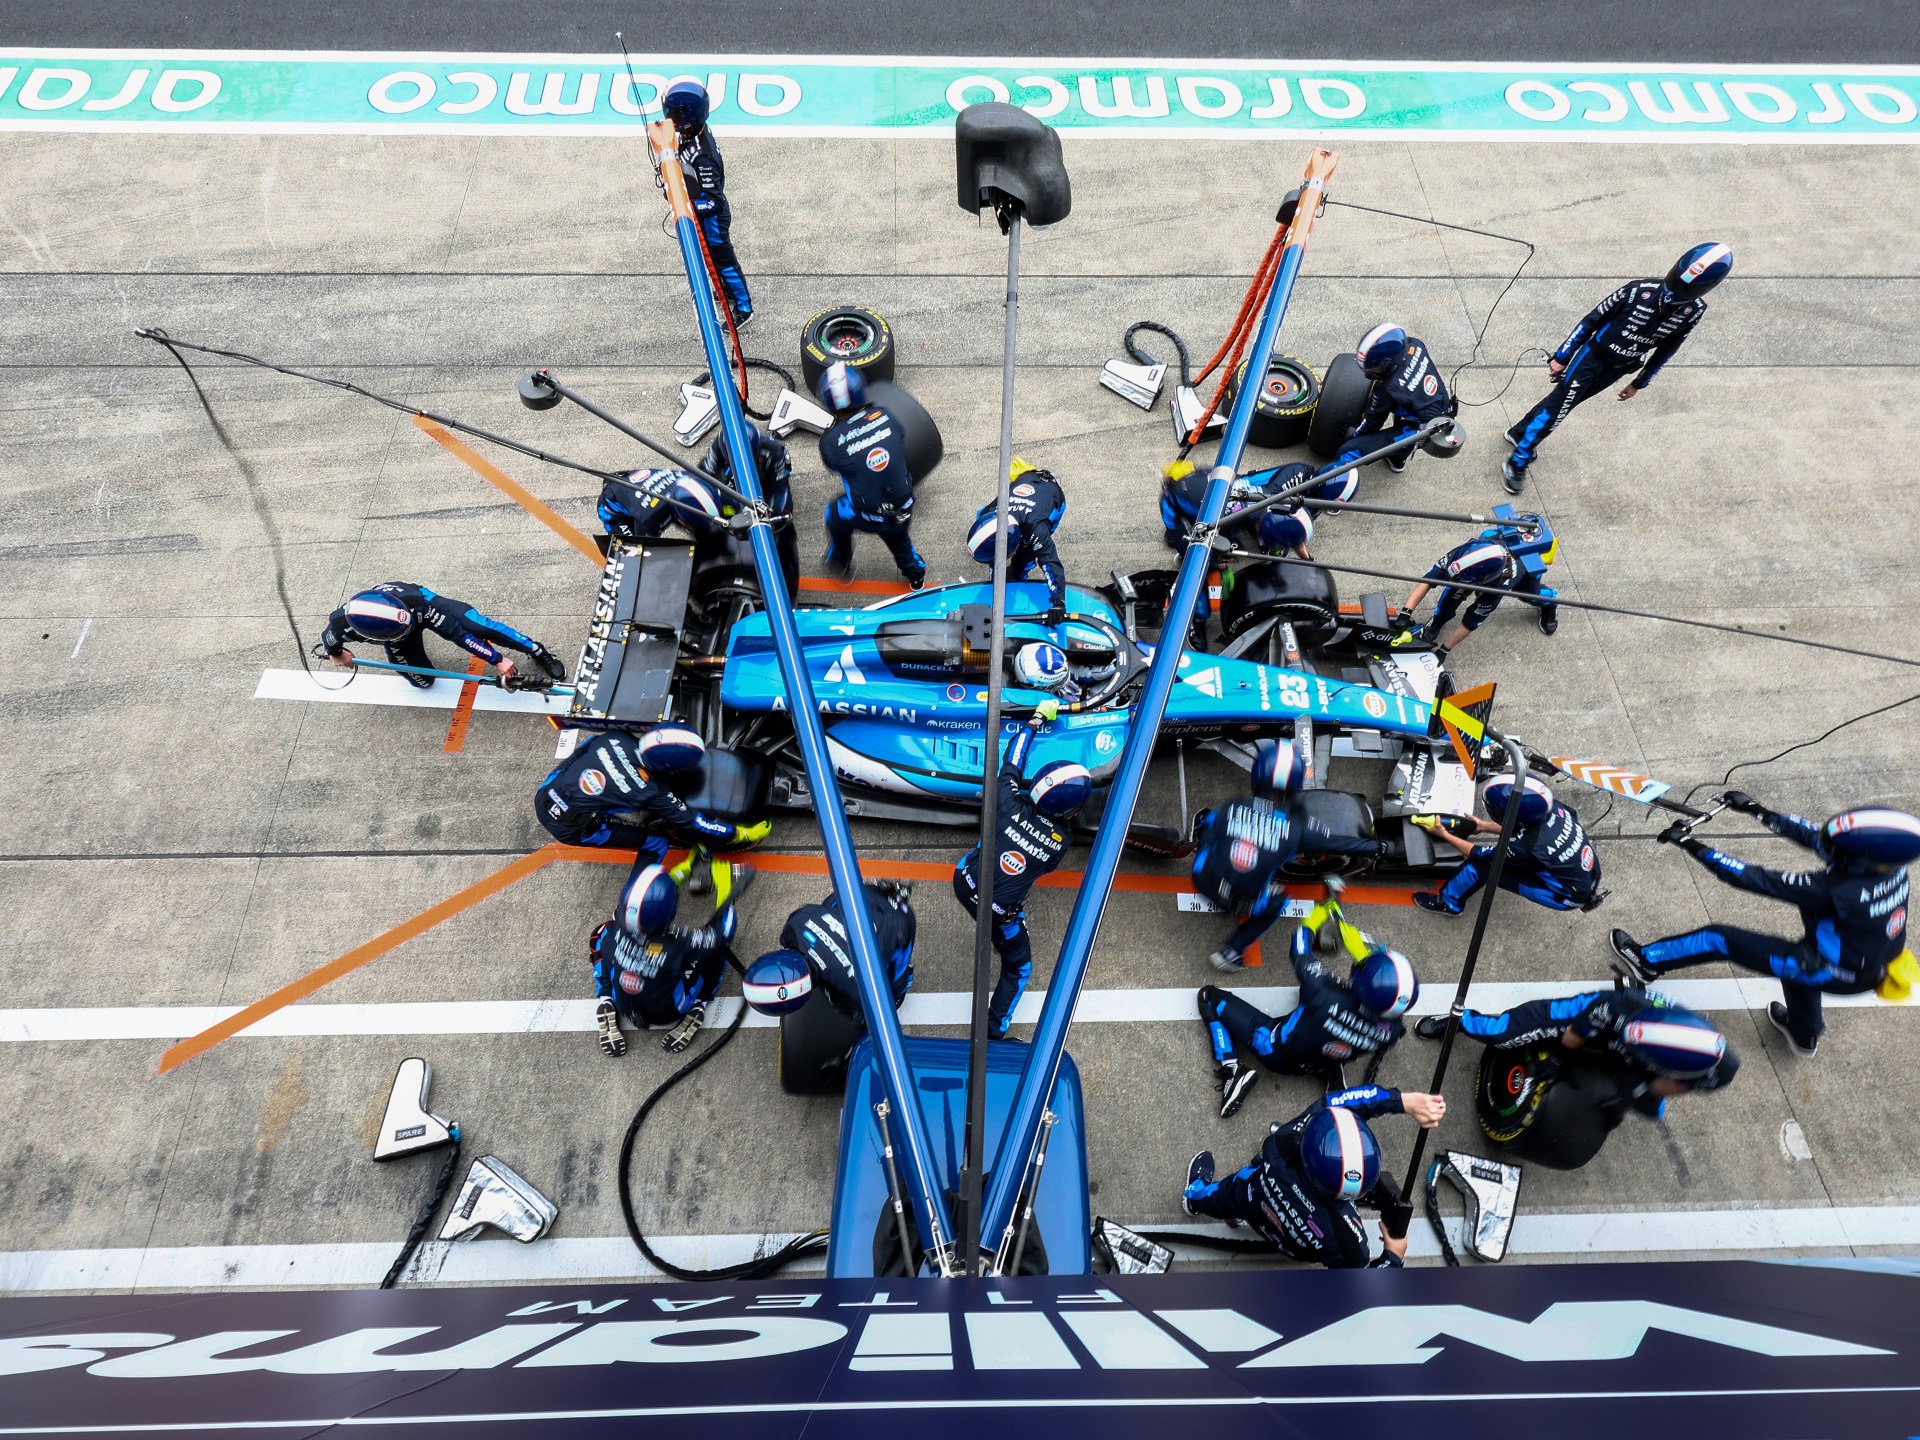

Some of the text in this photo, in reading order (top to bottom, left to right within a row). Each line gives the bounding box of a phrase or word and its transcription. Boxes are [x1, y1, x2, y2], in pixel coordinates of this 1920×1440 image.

[1504, 81, 1919, 124] aramco
[575, 556, 624, 701] ATLASSIAN
[1285, 621, 1297, 651] Claude
[1083, 643, 1107, 651] Claude
[901, 663, 954, 672] DURACELL
[1257, 664, 1270, 702] BARCLAYS
[1278, 673, 1310, 709] 23
[771, 696, 916, 724] AASSIAN
[938, 720, 981, 731] kraken
[1408, 752, 1428, 808] ATLASSIAN
[1004, 825, 1050, 862] KOMATSU
[1019, 820, 1062, 852] ATLASSIAN
[1001, 850, 1025, 874] Gulf
[1190, 902, 1201, 912] 30
[1293, 907, 1304, 917] 30
[1330, 1086, 1378, 1107] KOMATSU
[396, 1127, 423, 1140] SPARE
[1474, 1168, 1500, 1182] SPARE
[1259, 1173, 1307, 1248] KOMATSU
[1266, 1176, 1323, 1251] ATLASSIAN
[504, 1292, 918, 1317] TEAM
